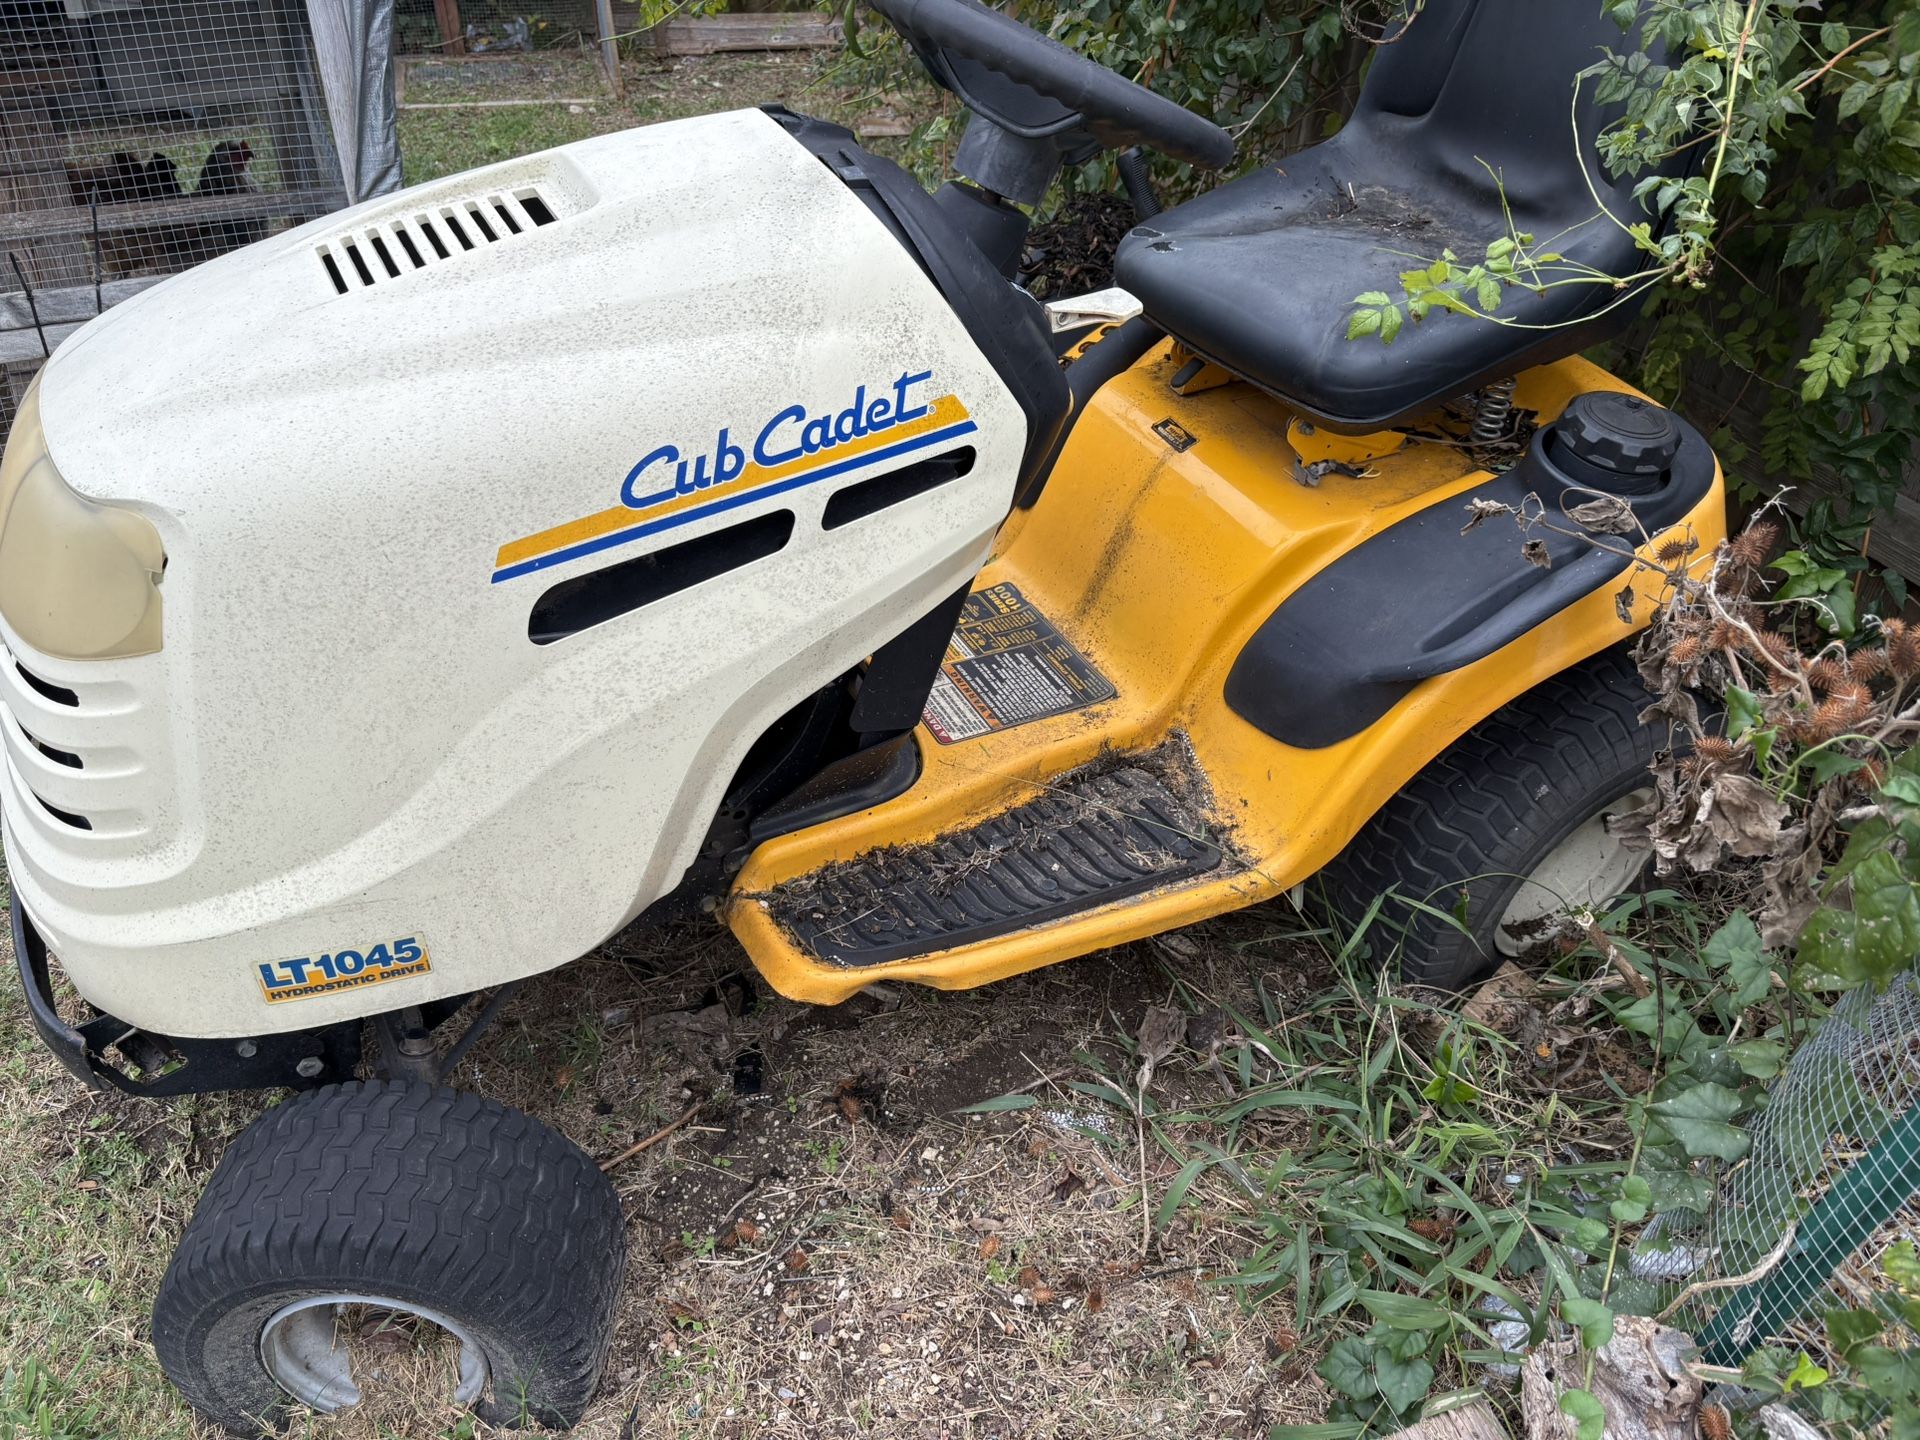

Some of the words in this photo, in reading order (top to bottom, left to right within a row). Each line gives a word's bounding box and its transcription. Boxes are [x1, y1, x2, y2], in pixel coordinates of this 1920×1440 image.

[620, 427, 746, 509] Cub
[752, 370, 932, 467] Cadet
[984, 589, 1011, 613] SERIES
[992, 585, 1023, 610] 1000
[949, 671, 988, 712] WARNING
[921, 707, 942, 731] DANG
[270, 974, 377, 1000] HYDROSTATIC
[380, 963, 426, 980] DRIVE
